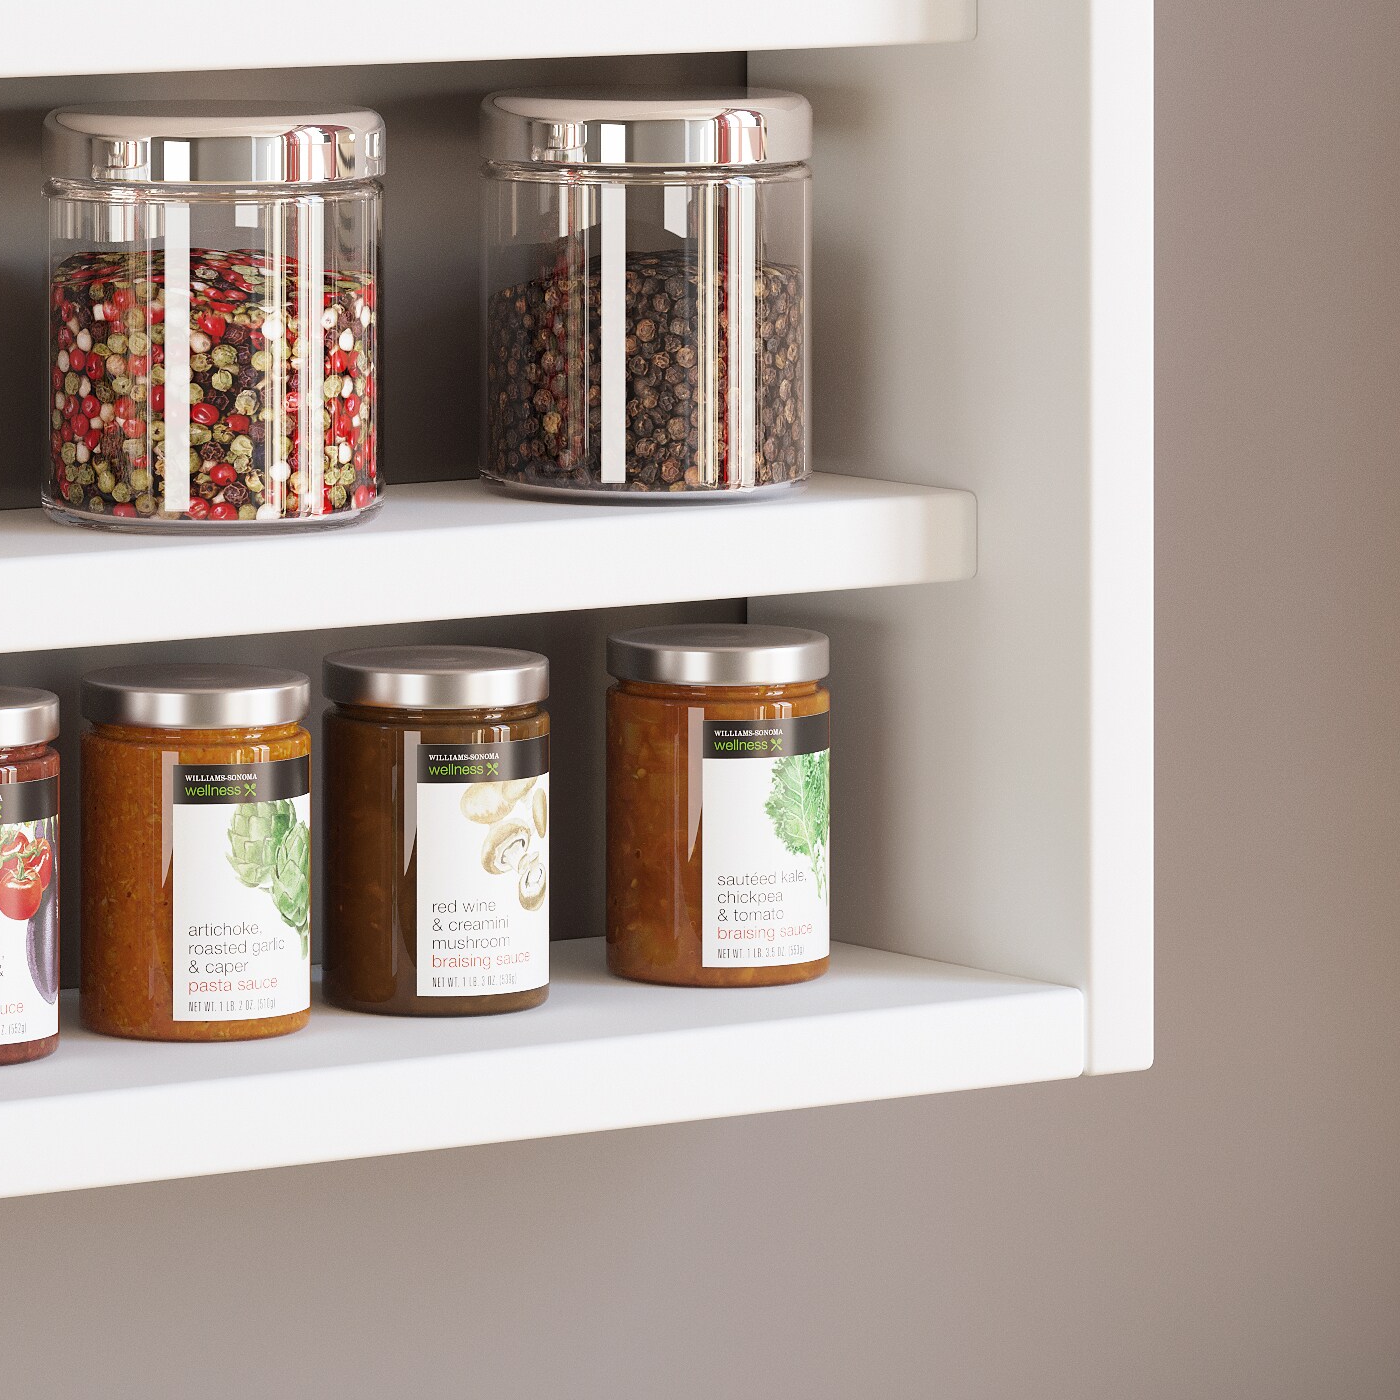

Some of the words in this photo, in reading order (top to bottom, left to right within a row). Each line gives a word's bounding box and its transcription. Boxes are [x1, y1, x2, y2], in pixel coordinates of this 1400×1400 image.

[714, 729, 783, 737] WILLIAMS-SONOMA
[714, 739, 768, 751] wellness
[429, 753, 499, 761] WILLIAMS-SONOMA
[429, 762, 484, 776] wellness
[185, 783, 241, 796] wellness
[717, 871, 776, 886] sautéed
[781, 869, 806, 883] kale,
[717, 890, 783, 906] chickpea
[433, 900, 457, 914] red
[463, 899, 496, 913] wine
[717, 908, 728, 922] &
[733, 907, 784, 921] tomato
[188, 922, 262, 937] artichoke,
[432, 918, 443, 932] &
[448, 915, 509, 931] creamini
[717, 927, 774, 942] braising
[780, 923, 812, 937] sauce
[188, 941, 247, 956] roasted
[252, 937, 285, 957] garlic
[433, 935, 510, 949] mushroom
[432, 953, 491, 970] braising
[497, 950, 531, 965] sauce
[718, 948, 730, 958] NET
[733, 948, 744, 958] WT.
[188, 960, 199, 974] &
[205, 960, 248, 976] caper
[188, 977, 232, 995] pasta
[238, 977, 277, 991] sauce
[433, 977, 444, 987] NET
[448, 977, 459, 987] WT.
[463, 977, 466, 987] 1
[188, 1002, 201, 1012] NET
[204, 1001, 216, 1012] WT.
[220, 1001, 223, 1011] 1
[227, 1001, 236, 1011] LB.
